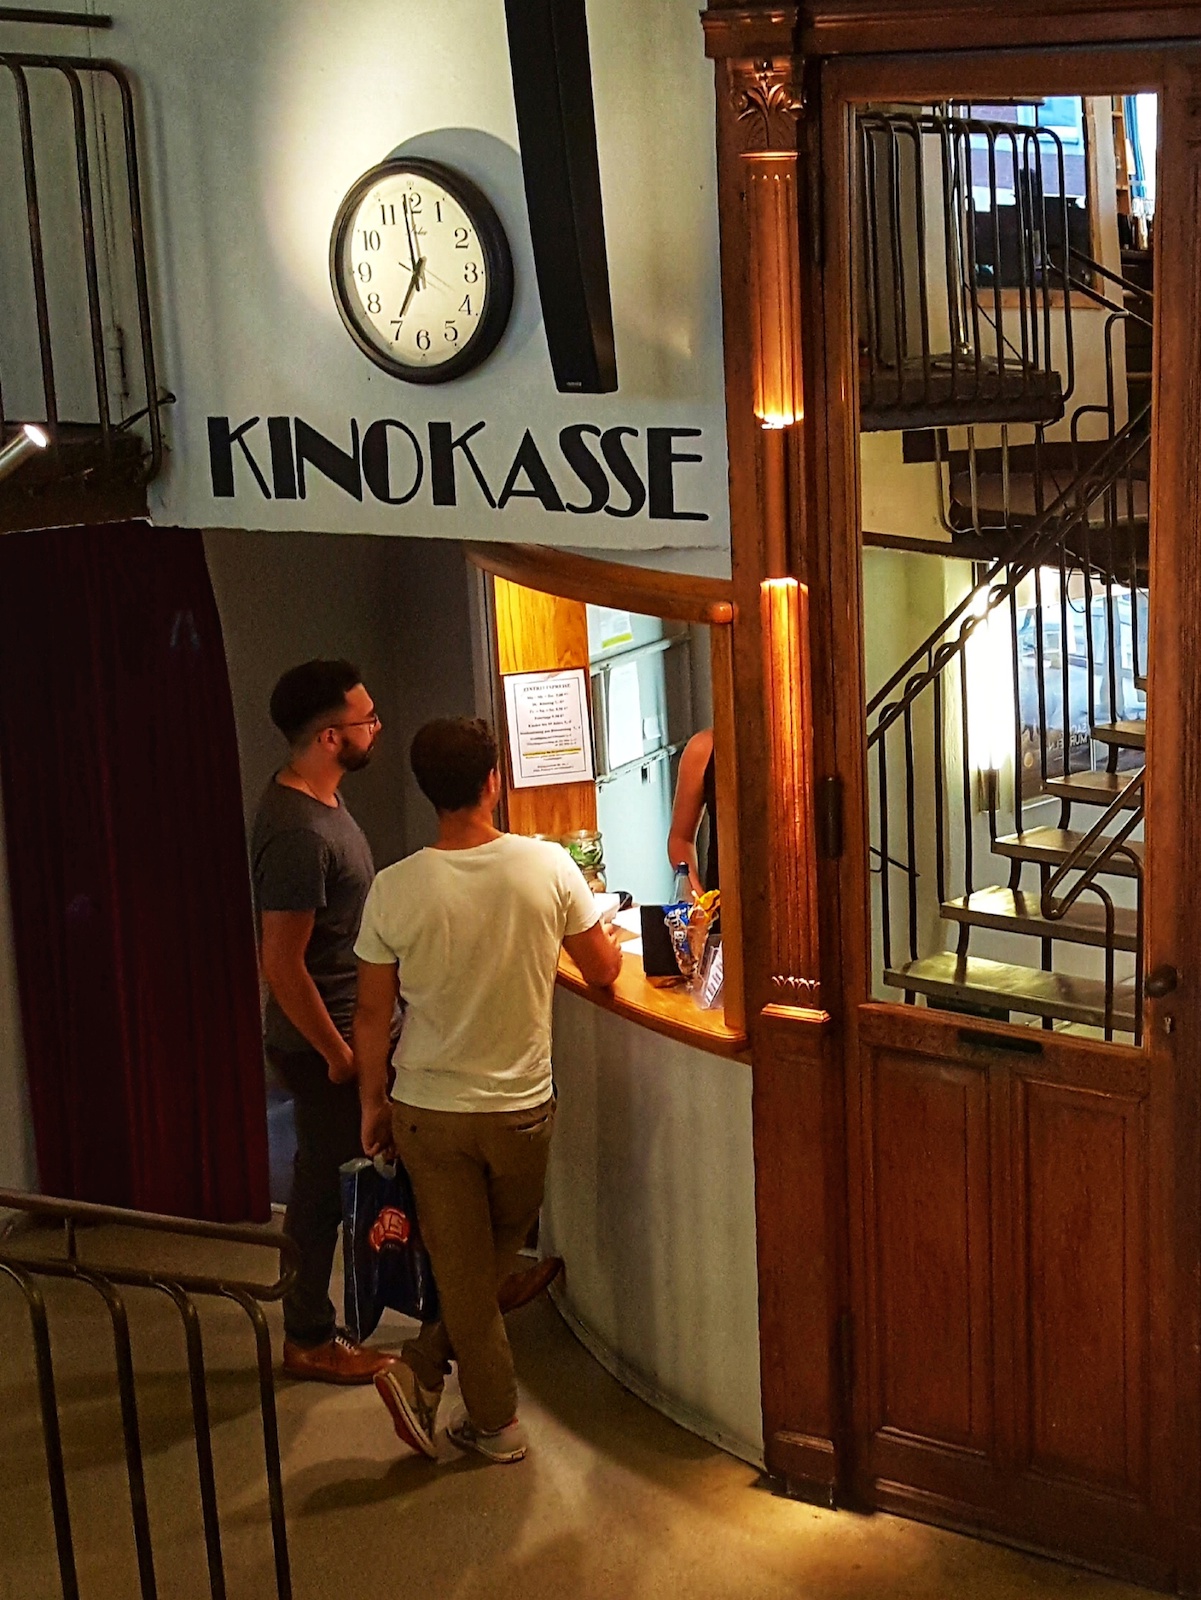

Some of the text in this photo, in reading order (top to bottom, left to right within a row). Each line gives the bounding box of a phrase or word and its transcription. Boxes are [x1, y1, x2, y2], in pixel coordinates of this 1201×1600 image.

[380, 203, 397, 225] 11
[401, 192, 423, 215] 12
[434, 201, 444, 223] 1
[362, 229, 381, 251] 10
[454, 227, 470, 249] 2
[357, 261, 372, 284] 9
[464, 261, 478, 284] 3
[367, 292, 382, 314] 8
[458, 294, 472, 316] 4
[389, 319, 404, 341] 7
[415, 328, 431, 351] 6
[444, 319, 459, 342] 5
[206, 416, 709, 522] KINOKASSE
